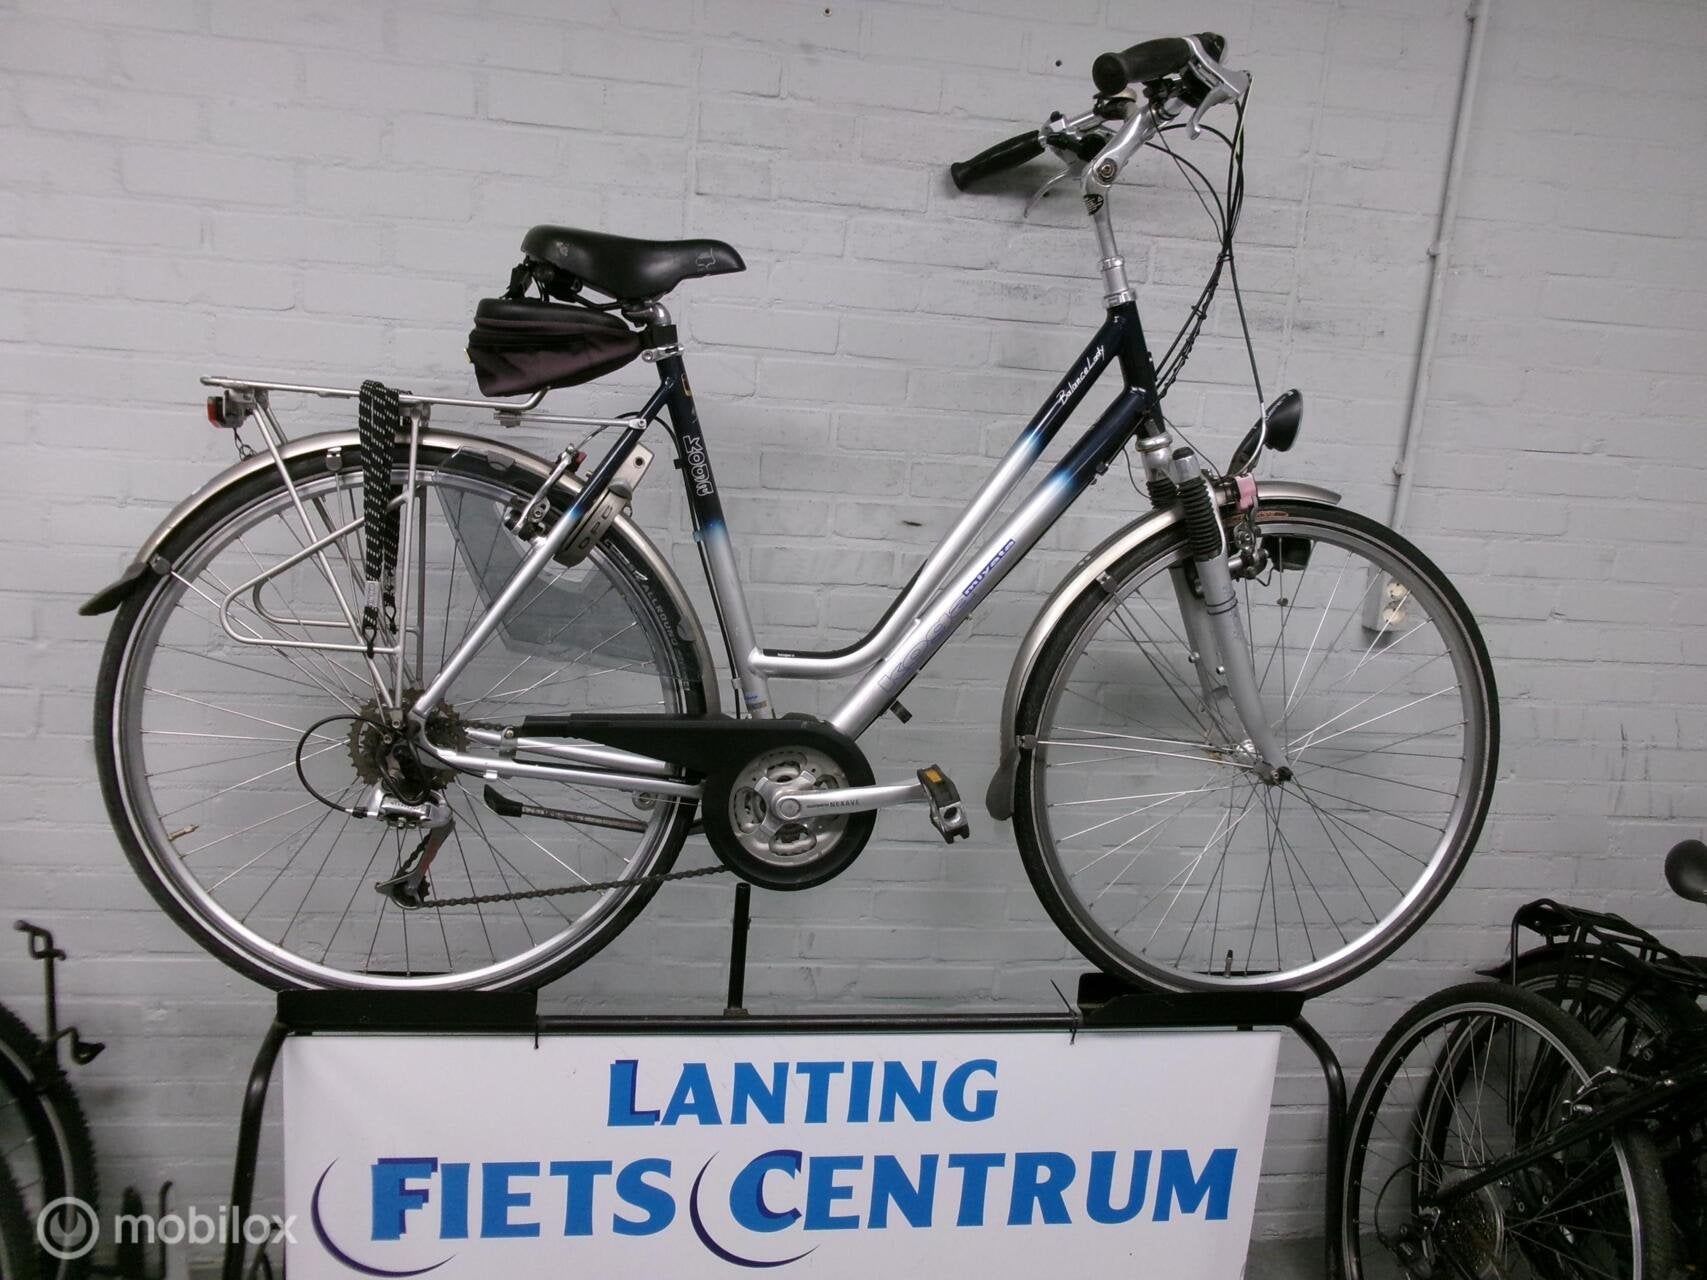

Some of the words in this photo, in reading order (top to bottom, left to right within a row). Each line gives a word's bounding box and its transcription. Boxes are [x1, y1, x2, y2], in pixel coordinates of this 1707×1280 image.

[682, 435, 714, 496] koga
[963, 539, 1015, 596] miyata
[608, 1059, 998, 1128] LANTING
